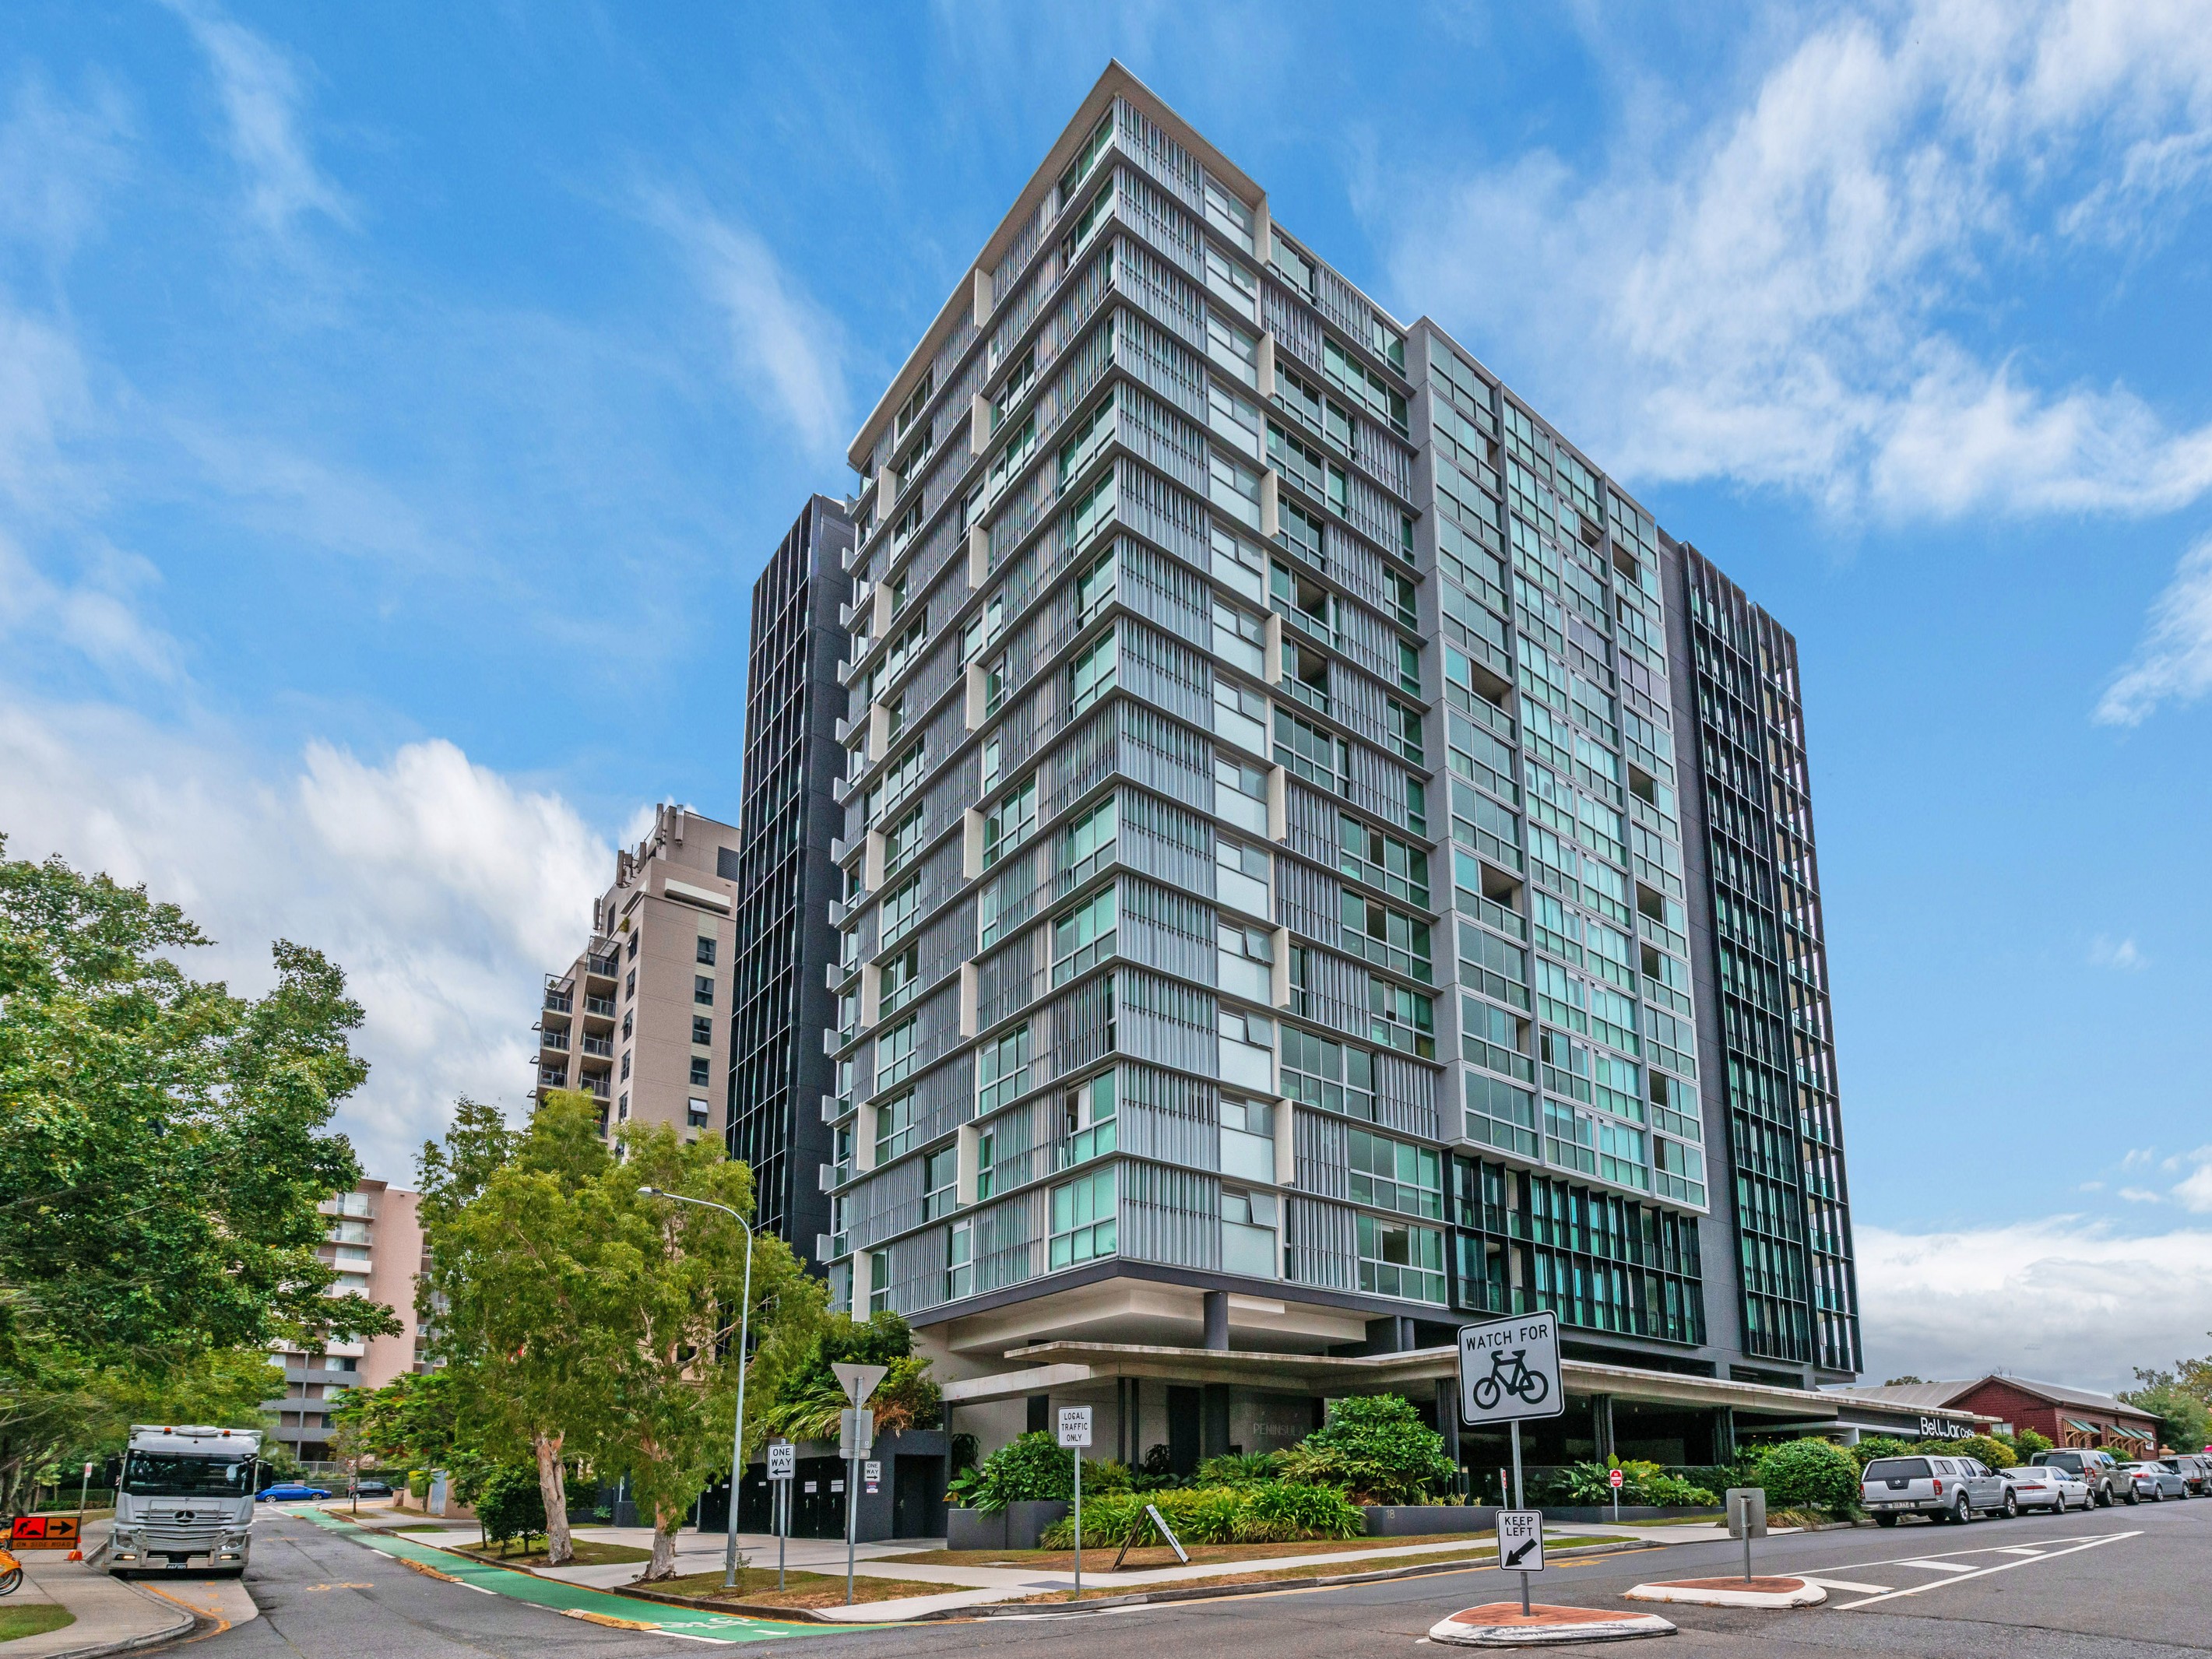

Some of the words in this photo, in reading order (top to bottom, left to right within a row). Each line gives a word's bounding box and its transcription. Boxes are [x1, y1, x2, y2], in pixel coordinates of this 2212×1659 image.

[1466, 1330, 1512, 1351] WATCH
[1520, 1324, 1548, 1342] FOR
[1064, 1411, 1085, 1421] LOCAL
[1061, 1422, 1088, 1431] TRAFFIC
[1253, 1423, 1306, 1437] PENINSULA
[1920, 1416, 1946, 1437] Bell
[1945, 1419, 1960, 1438] Jar
[1066, 1433, 1082, 1442] ONLY
[772, 1448, 791, 1457] ONE
[771, 1457, 792, 1467] WAY
[1386, 1509, 1395, 1519] 18
[1504, 1516, 1534, 1526] KEEP
[1506, 1527, 1533, 1537] LEFT
